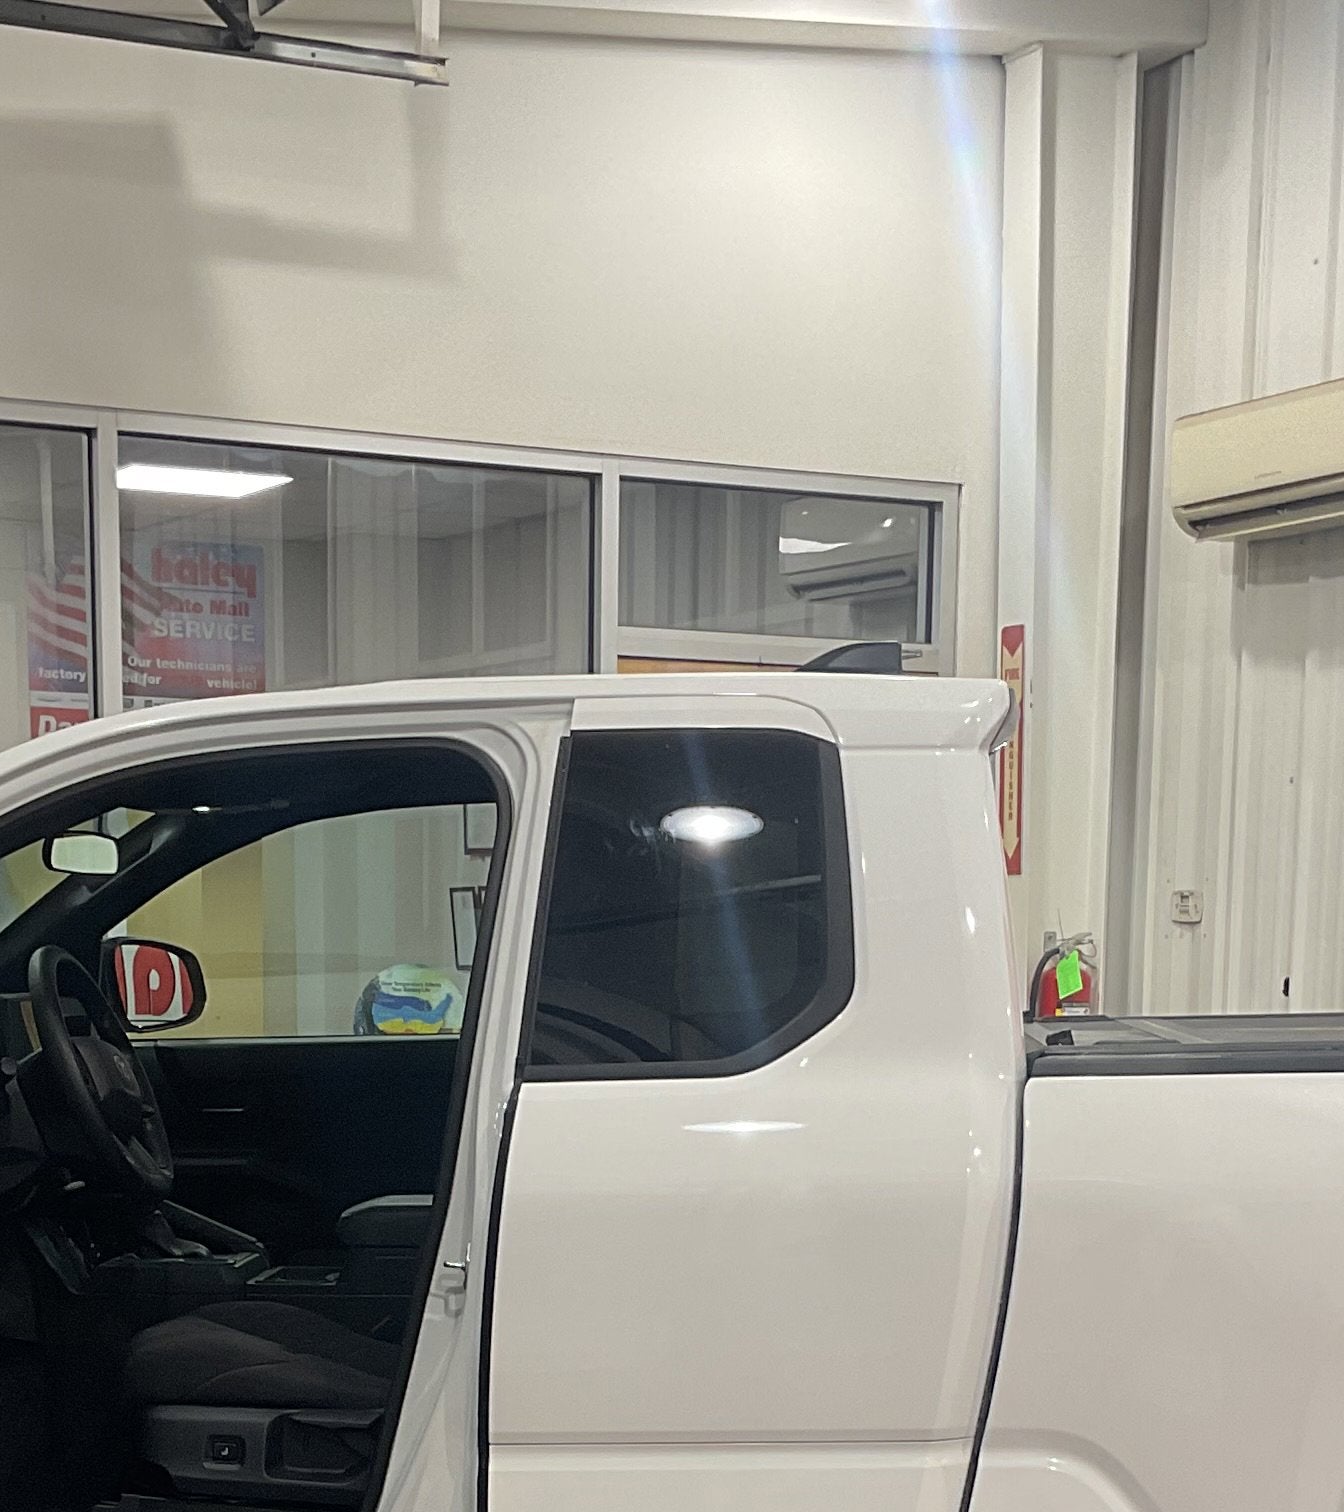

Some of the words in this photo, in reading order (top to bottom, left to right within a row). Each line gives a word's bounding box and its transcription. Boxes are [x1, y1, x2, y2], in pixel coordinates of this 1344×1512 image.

[210, 600, 250, 617] Mall
[154, 619, 256, 641] SERVICE
[127, 656, 152, 668] Our
[156, 658, 232, 672] technicians
[39, 667, 86, 683] factory
